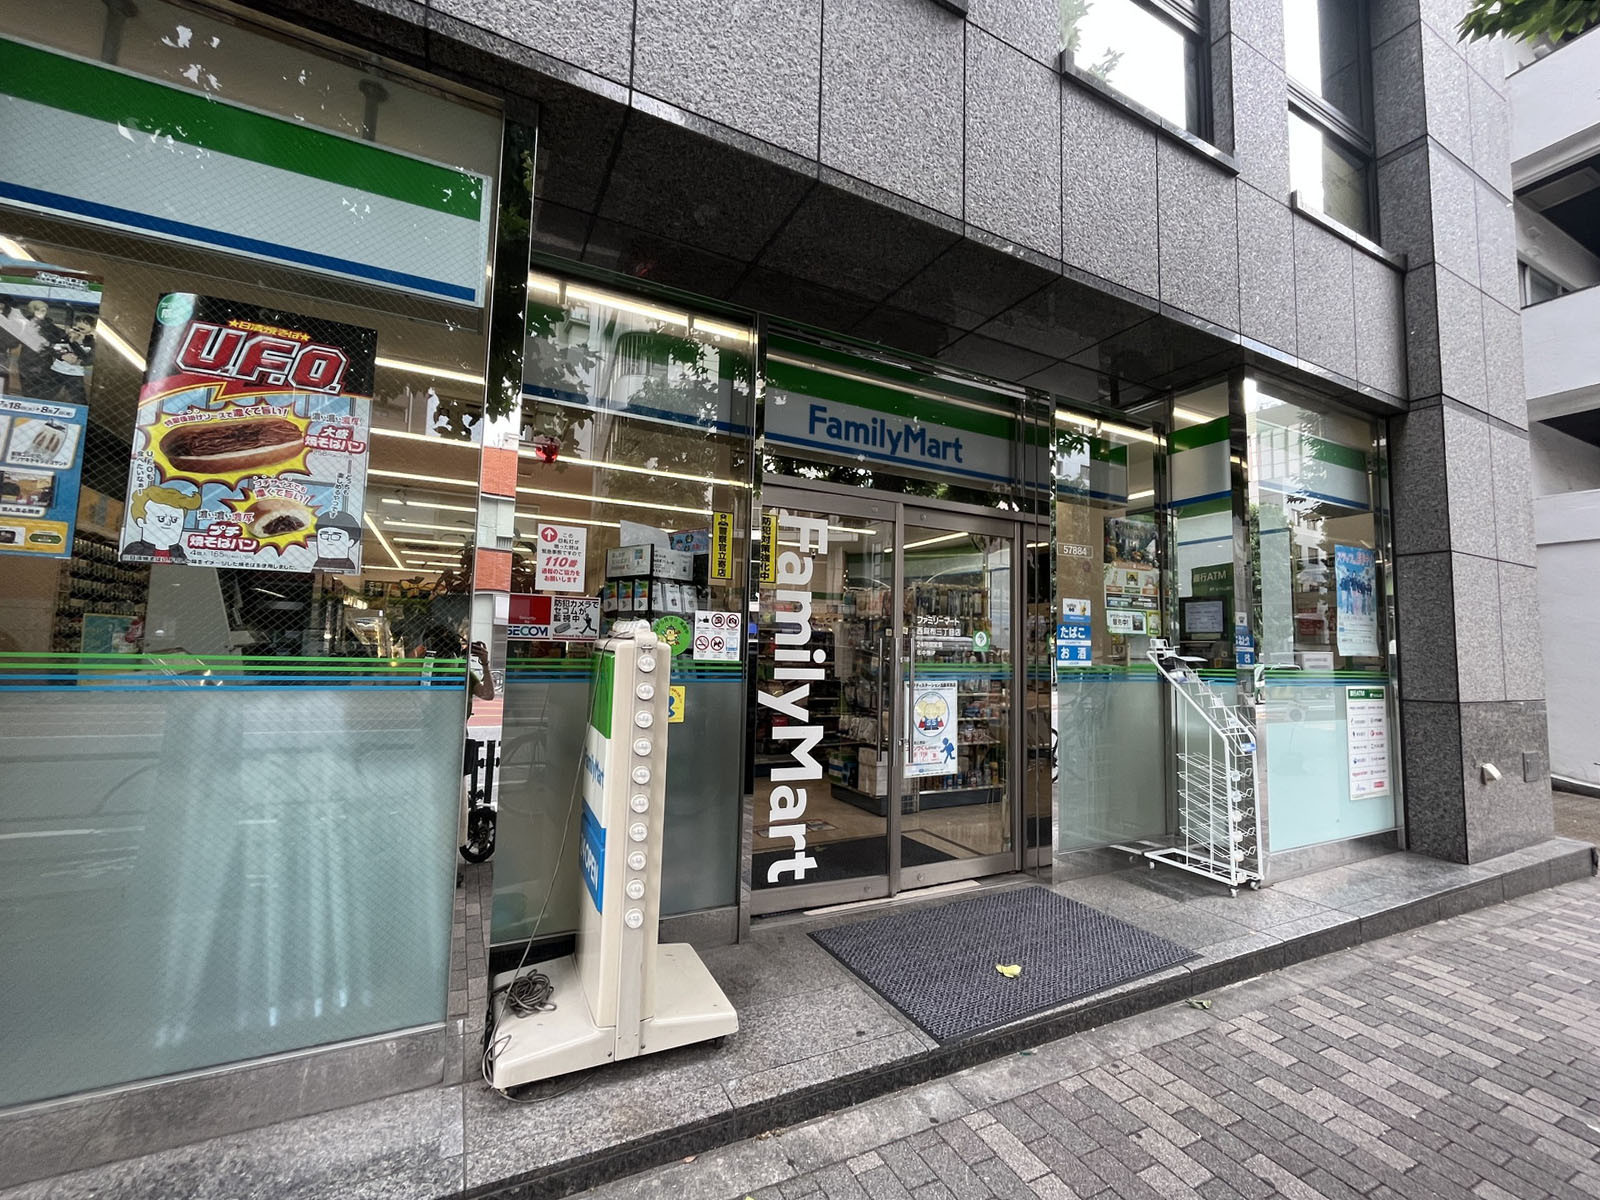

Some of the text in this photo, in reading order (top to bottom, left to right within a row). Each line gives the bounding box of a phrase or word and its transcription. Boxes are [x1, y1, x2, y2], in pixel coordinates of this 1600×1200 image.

[809, 404, 963, 463] FamilyMart
[305, 436, 364, 451] 焼そばパン
[209, 525, 240, 537] プチ
[189, 535, 257, 550] 焼そばパン
[717, 527, 728, 577] 警察官立寄店
[760, 517, 771, 580] 防犯対策強化中
[1064, 545, 1087, 556] 57884
[545, 557, 578, 567] 110番
[542, 568, 580, 576] 通報のご協力を
[554, 599, 599, 608] 防犯カメラで
[554, 607, 586, 615] セコムが
[554, 614, 579, 622] 監視中
[917, 615, 960, 626] ファミリーマート
[508, 626, 548, 637] SECOM
[917, 627, 961, 636] 西麻布三丁目店
[1060, 626, 1086, 639] たばこ
[1061, 647, 1087, 660] お酒
[758, 514, 828, 883] FamilyMart
